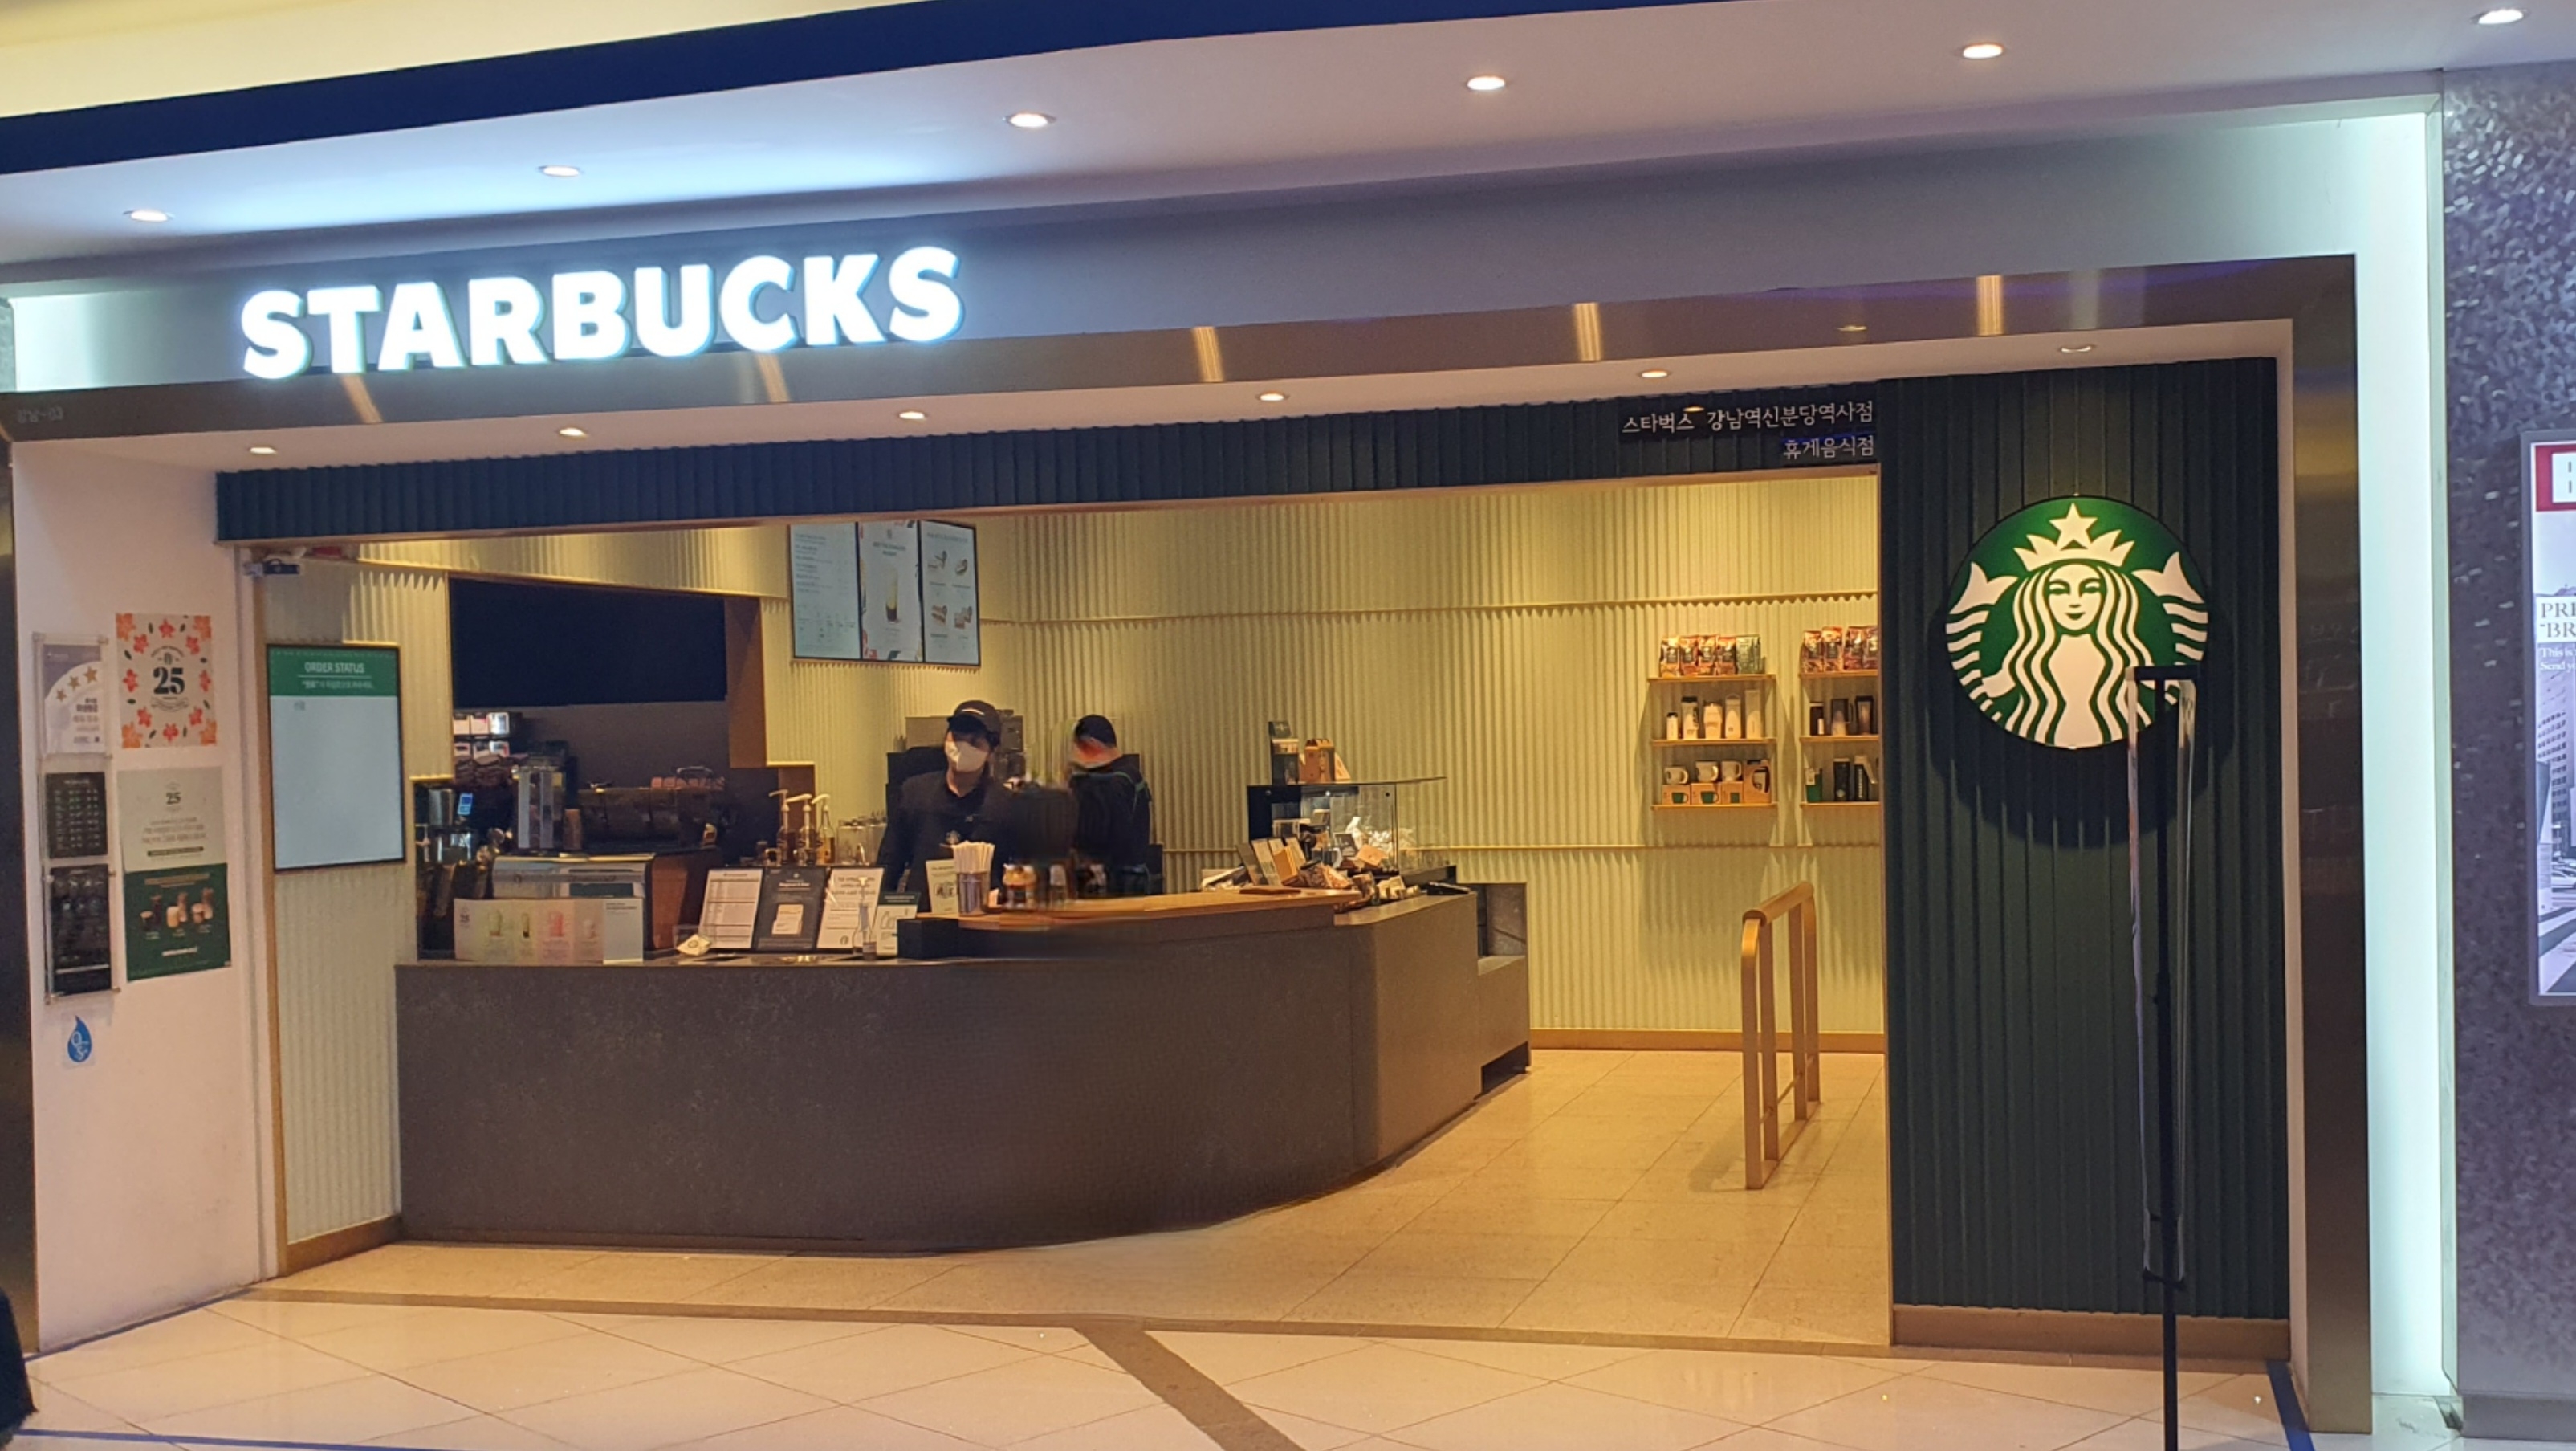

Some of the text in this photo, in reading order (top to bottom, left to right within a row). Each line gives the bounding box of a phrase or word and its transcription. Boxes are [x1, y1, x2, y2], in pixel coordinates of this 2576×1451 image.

[242, 247, 966, 379] STARBUCKS
[1622, 400, 1874, 433] 스타벅스 강남역신분당역사점
[1784, 435, 1874, 459] 휴게음식점
[153, 666, 185, 695] 25
[304, 661, 366, 674] ORDER STATUS
[165, 791, 181, 805] 25
